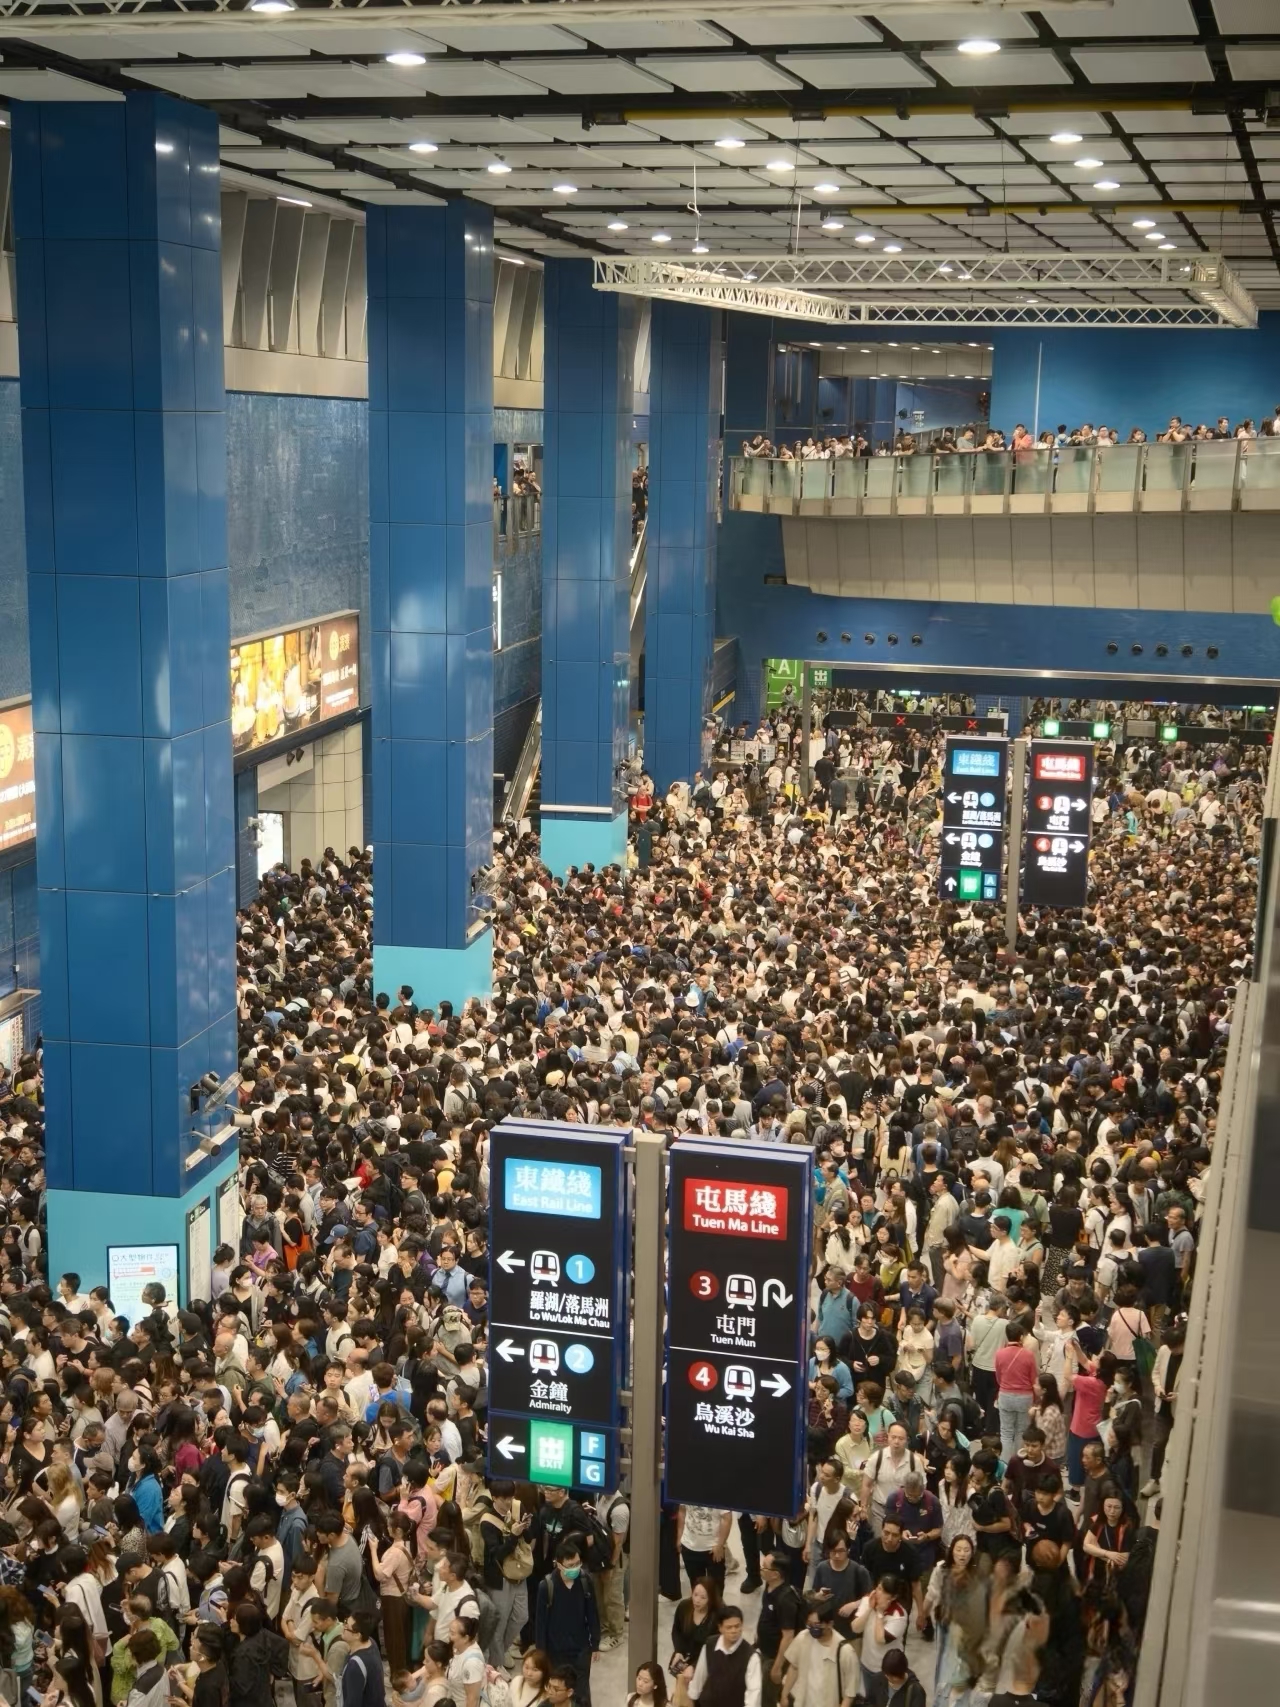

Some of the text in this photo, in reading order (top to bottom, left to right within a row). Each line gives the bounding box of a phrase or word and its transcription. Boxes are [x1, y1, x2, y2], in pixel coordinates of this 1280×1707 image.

[777, 659, 791, 675] A
[814, 669, 828, 681] 出
[986, 876, 994, 885] A
[986, 888, 993, 897] B
[513, 1165, 592, 1198] 東鐵綫
[512, 1193, 593, 1213] East Rail Line
[695, 1185, 777, 1219] 屯馬綫
[692, 1214, 779, 1235] Tuen Ma Line
[575, 1260, 583, 1279] 1
[698, 1275, 712, 1296] 3
[530, 1290, 609, 1318] 羅湖/落馬洲
[530, 1310, 610, 1328] Lo Wu/Lok Ma Chau
[716, 1313, 756, 1337] 屯門
[710, 1333, 756, 1348] Tuen Mun
[573, 1349, 586, 1369] 2
[695, 1366, 711, 1387] 4
[530, 1379, 568, 1402] 金鐘
[529, 1399, 572, 1415] Admiralty
[704, 1423, 755, 1438] Wu Kai Sha
[588, 1436, 599, 1454] F
[538, 1457, 562, 1470] EXIT
[586, 1464, 600, 1482] G
